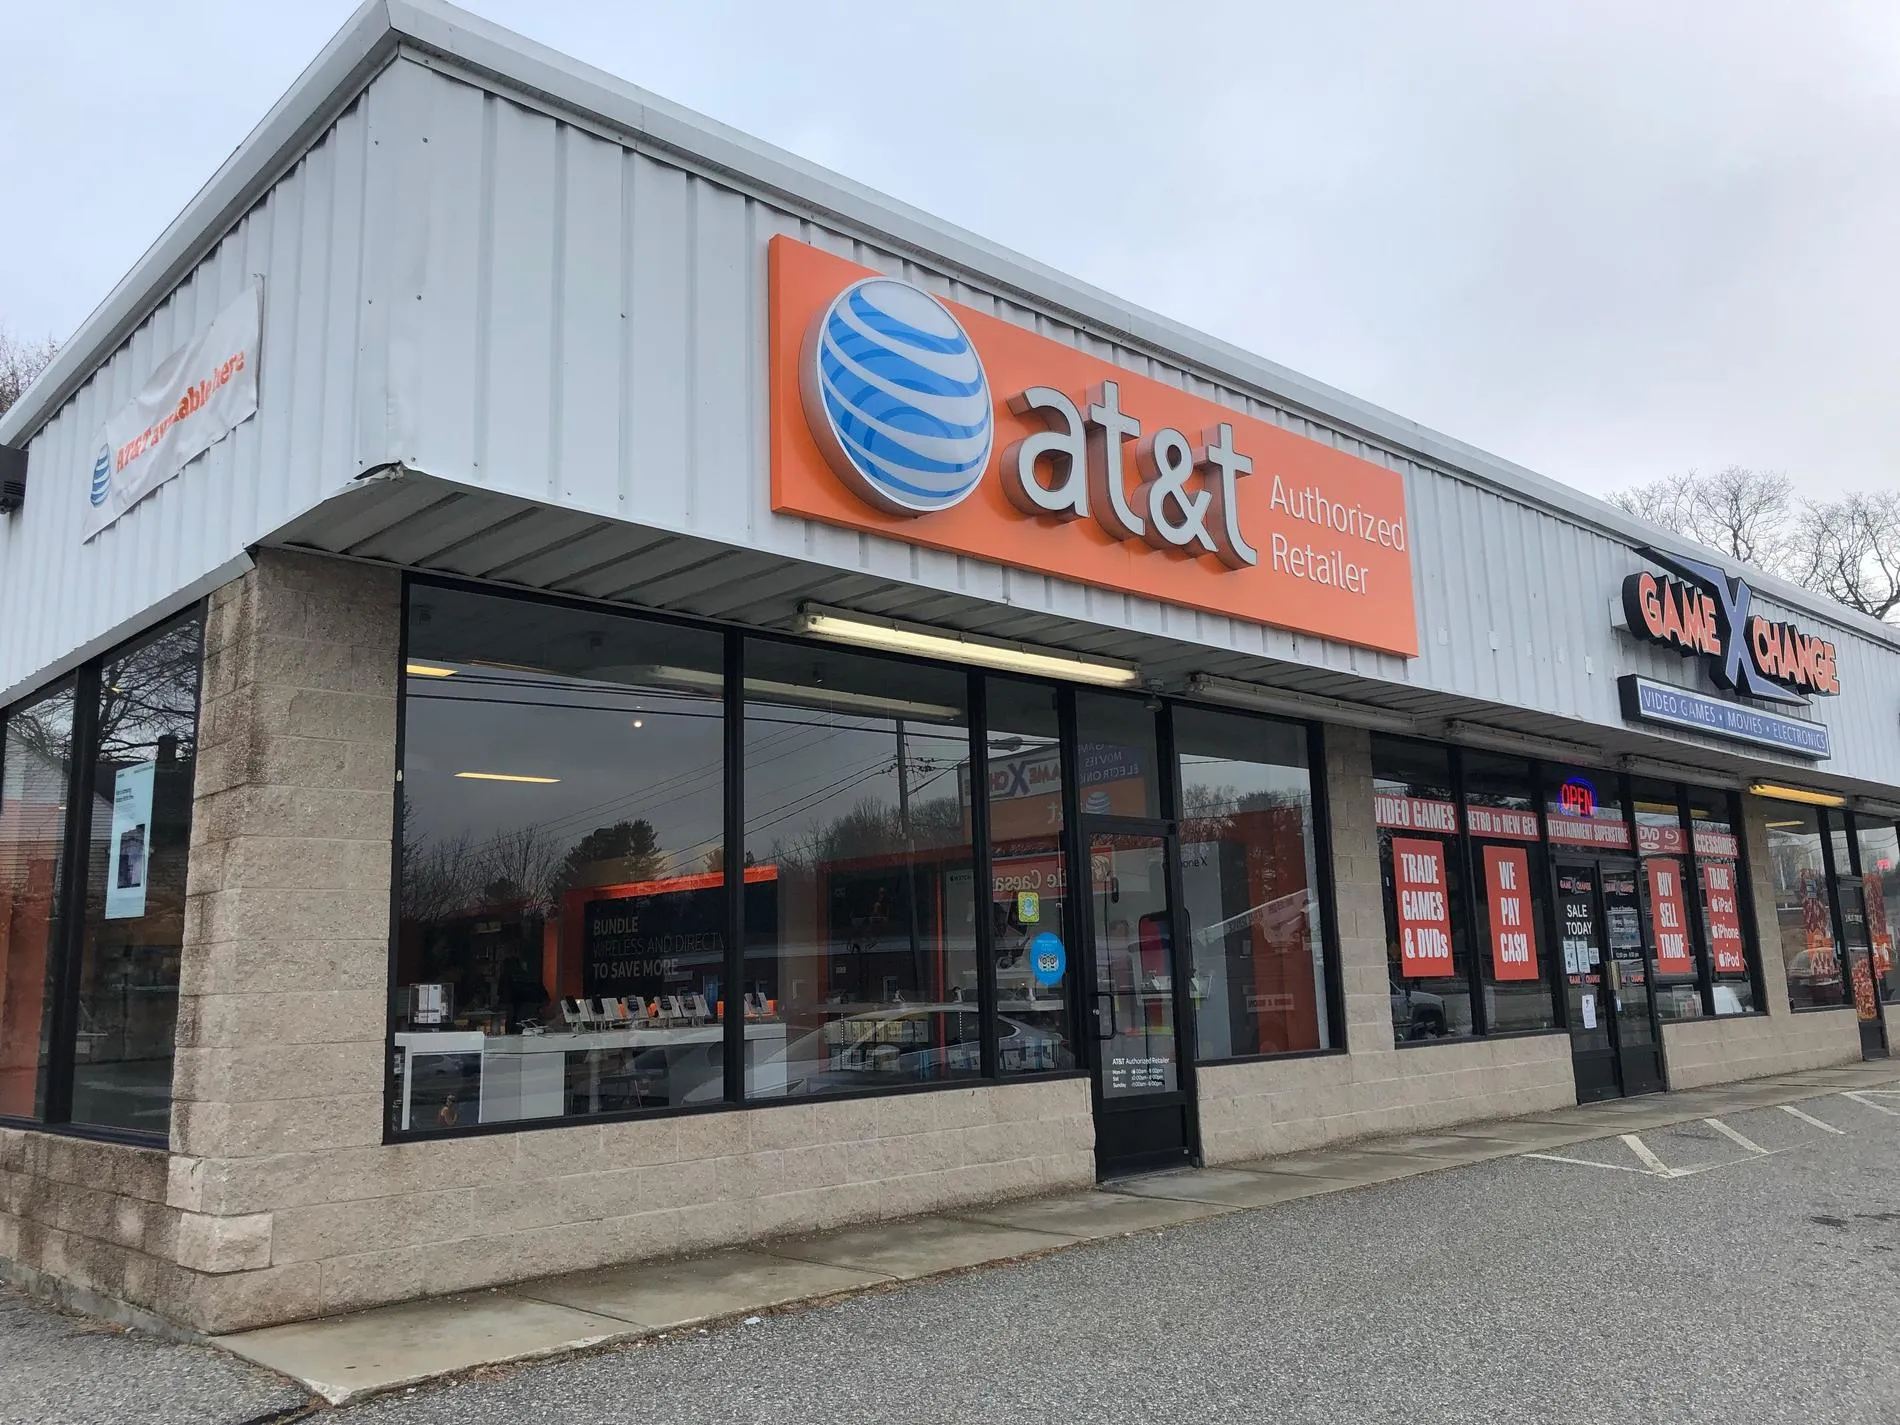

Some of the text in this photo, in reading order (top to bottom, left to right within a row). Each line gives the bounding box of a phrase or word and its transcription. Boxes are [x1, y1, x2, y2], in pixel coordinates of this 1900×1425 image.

[1008, 379, 1258, 568] at&t
[1269, 475, 1406, 552] Authorized
[1271, 533, 1369, 595] Retailer
[1643, 689, 1826, 750] VIDEO GAMES MOVIES ELECTRONICS
[1561, 783, 1594, 816] OPEN
[1374, 797, 1455, 831] VIDEO GAMES
[1493, 814, 1501, 833] to
[1502, 814, 1521, 834] NEW
[1522, 816, 1538, 836] GEN
[1547, 819, 1629, 844] NTERTAINMENT SUPERSTORE
[1639, 826, 1660, 842] DVD
[1400, 853, 1439, 884] TRADE
[1498, 861, 1517, 890] WE
[1708, 867, 1730, 890] TRADE
[1657, 871, 1672, 897] BUY
[1402, 890, 1444, 921] GAMES
[1500, 897, 1520, 926] PAY
[1567, 904, 1588, 918] SALE
[1659, 902, 1679, 928] SELL
[1717, 896, 1733, 913] iPad
[593, 916, 639, 936] BUNDLE
[1566, 921, 1592, 936] TODAY
[1717, 923, 1740, 939] iPhone
[647, 935, 673, 953] AND
[1404, 928, 1449, 959] & DVDs
[1659, 934, 1686, 958] TRADE
[592, 958, 679, 980] TO SAVE MORE
[1724, 951, 1740, 967] iPod
[1125, 1057, 1151, 1065] Authorized
[1152, 1056, 1169, 1064] Retailer
